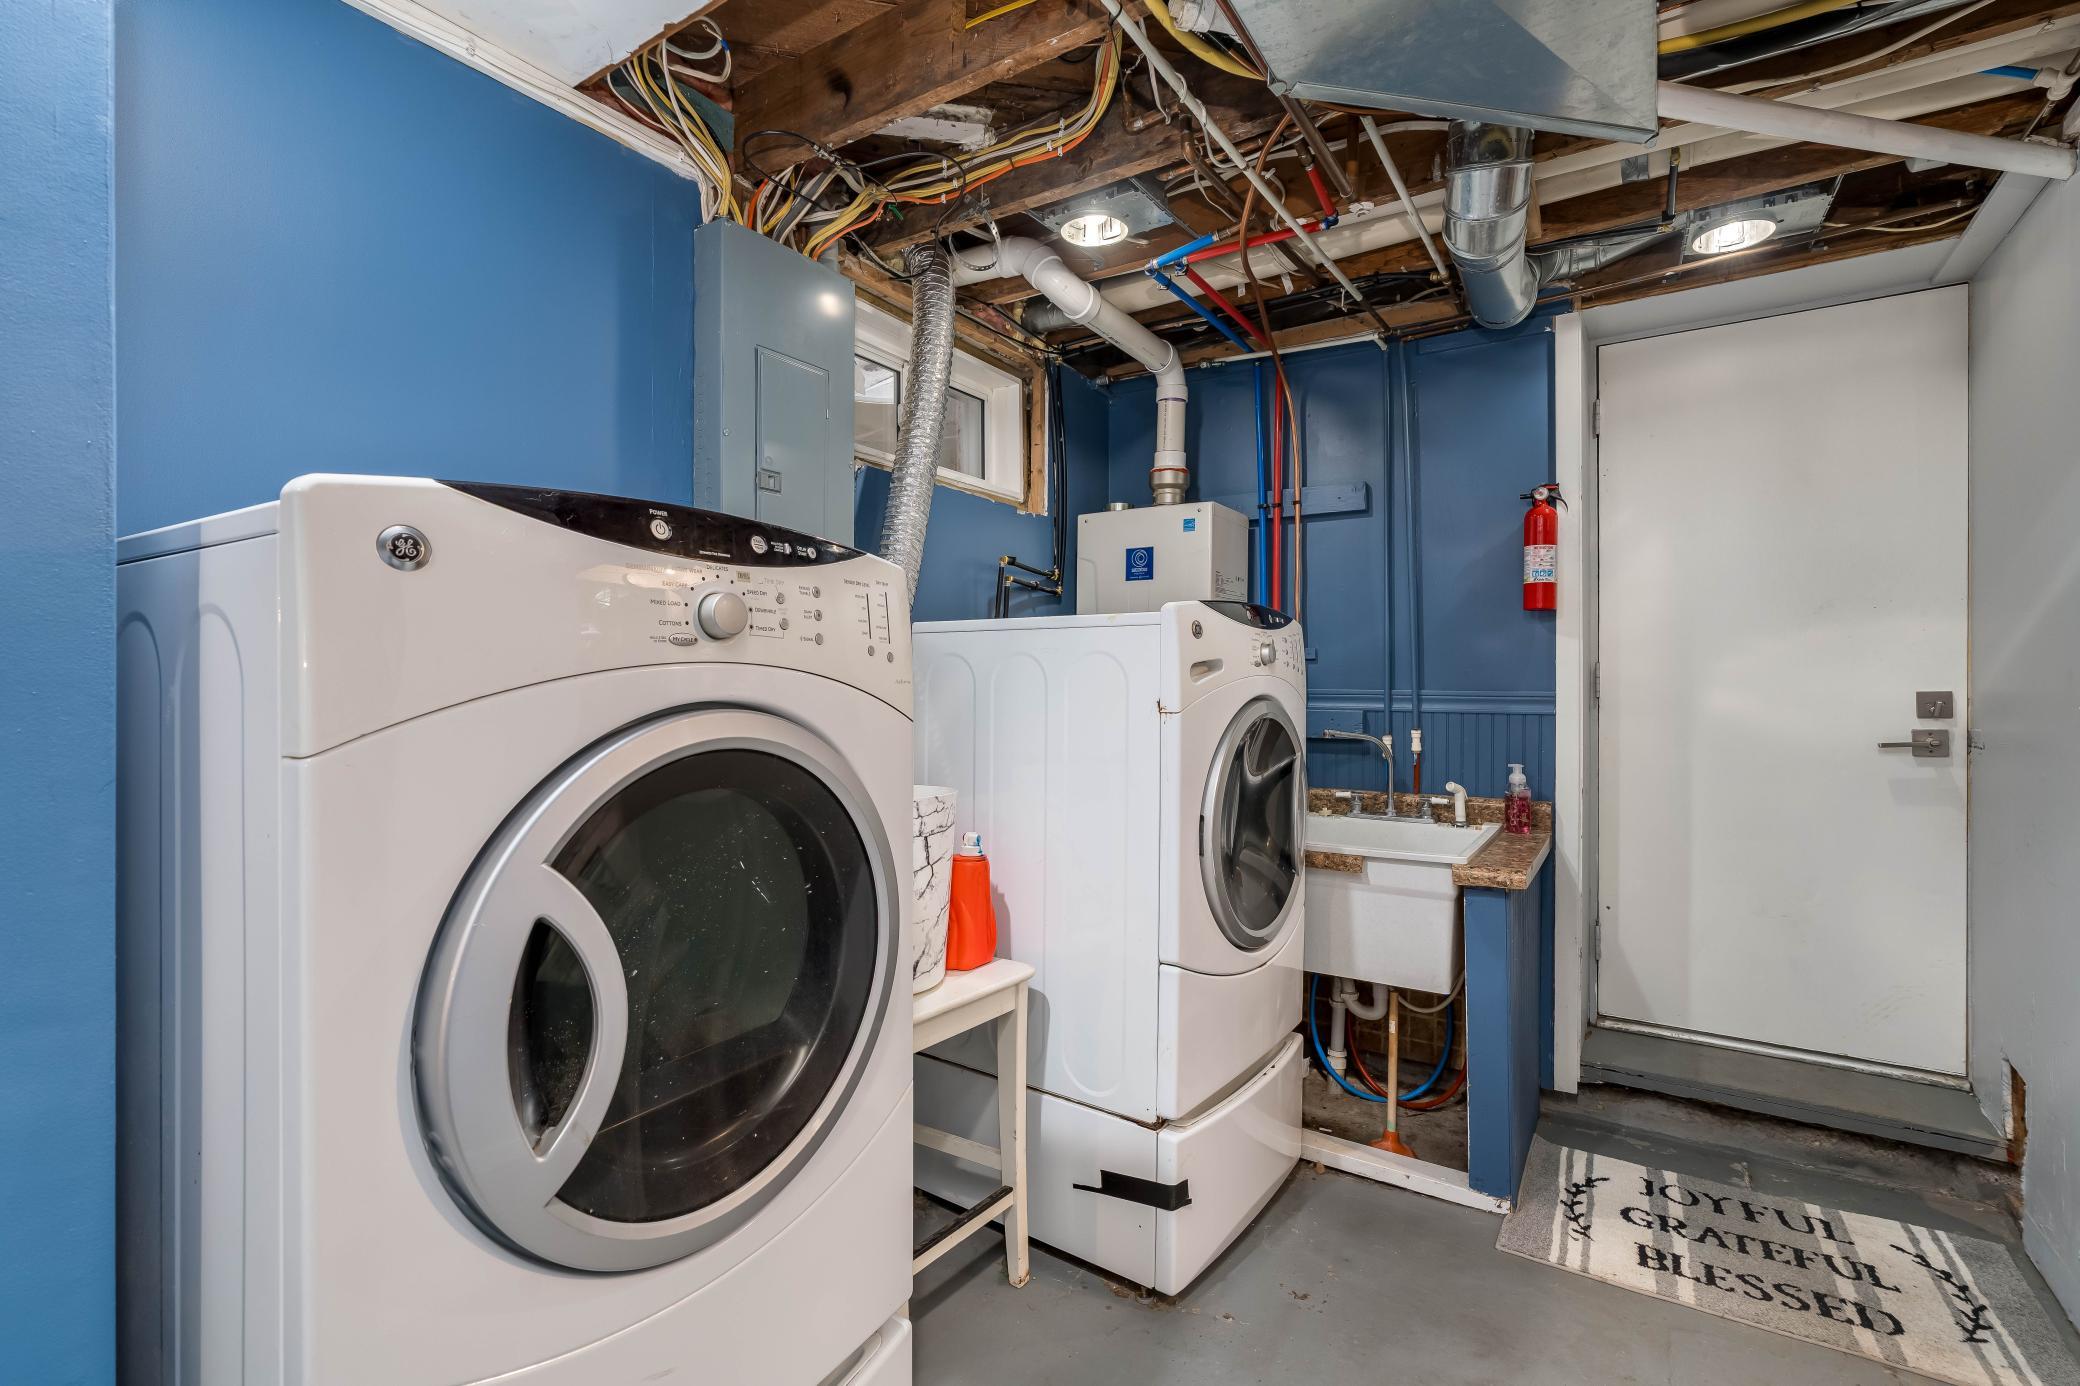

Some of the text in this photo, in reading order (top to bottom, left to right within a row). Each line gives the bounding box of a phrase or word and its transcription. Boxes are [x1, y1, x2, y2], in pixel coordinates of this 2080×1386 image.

[648, 508, 669, 517] POWER
[706, 564, 729, 572] DELICATES
[658, 619, 682, 627] COTTONS
[1639, 1176, 1855, 1245] JOYFUL
[1620, 1206, 1902, 1293] GRATEFUL
[1634, 1242, 1905, 1335] BLESSED
